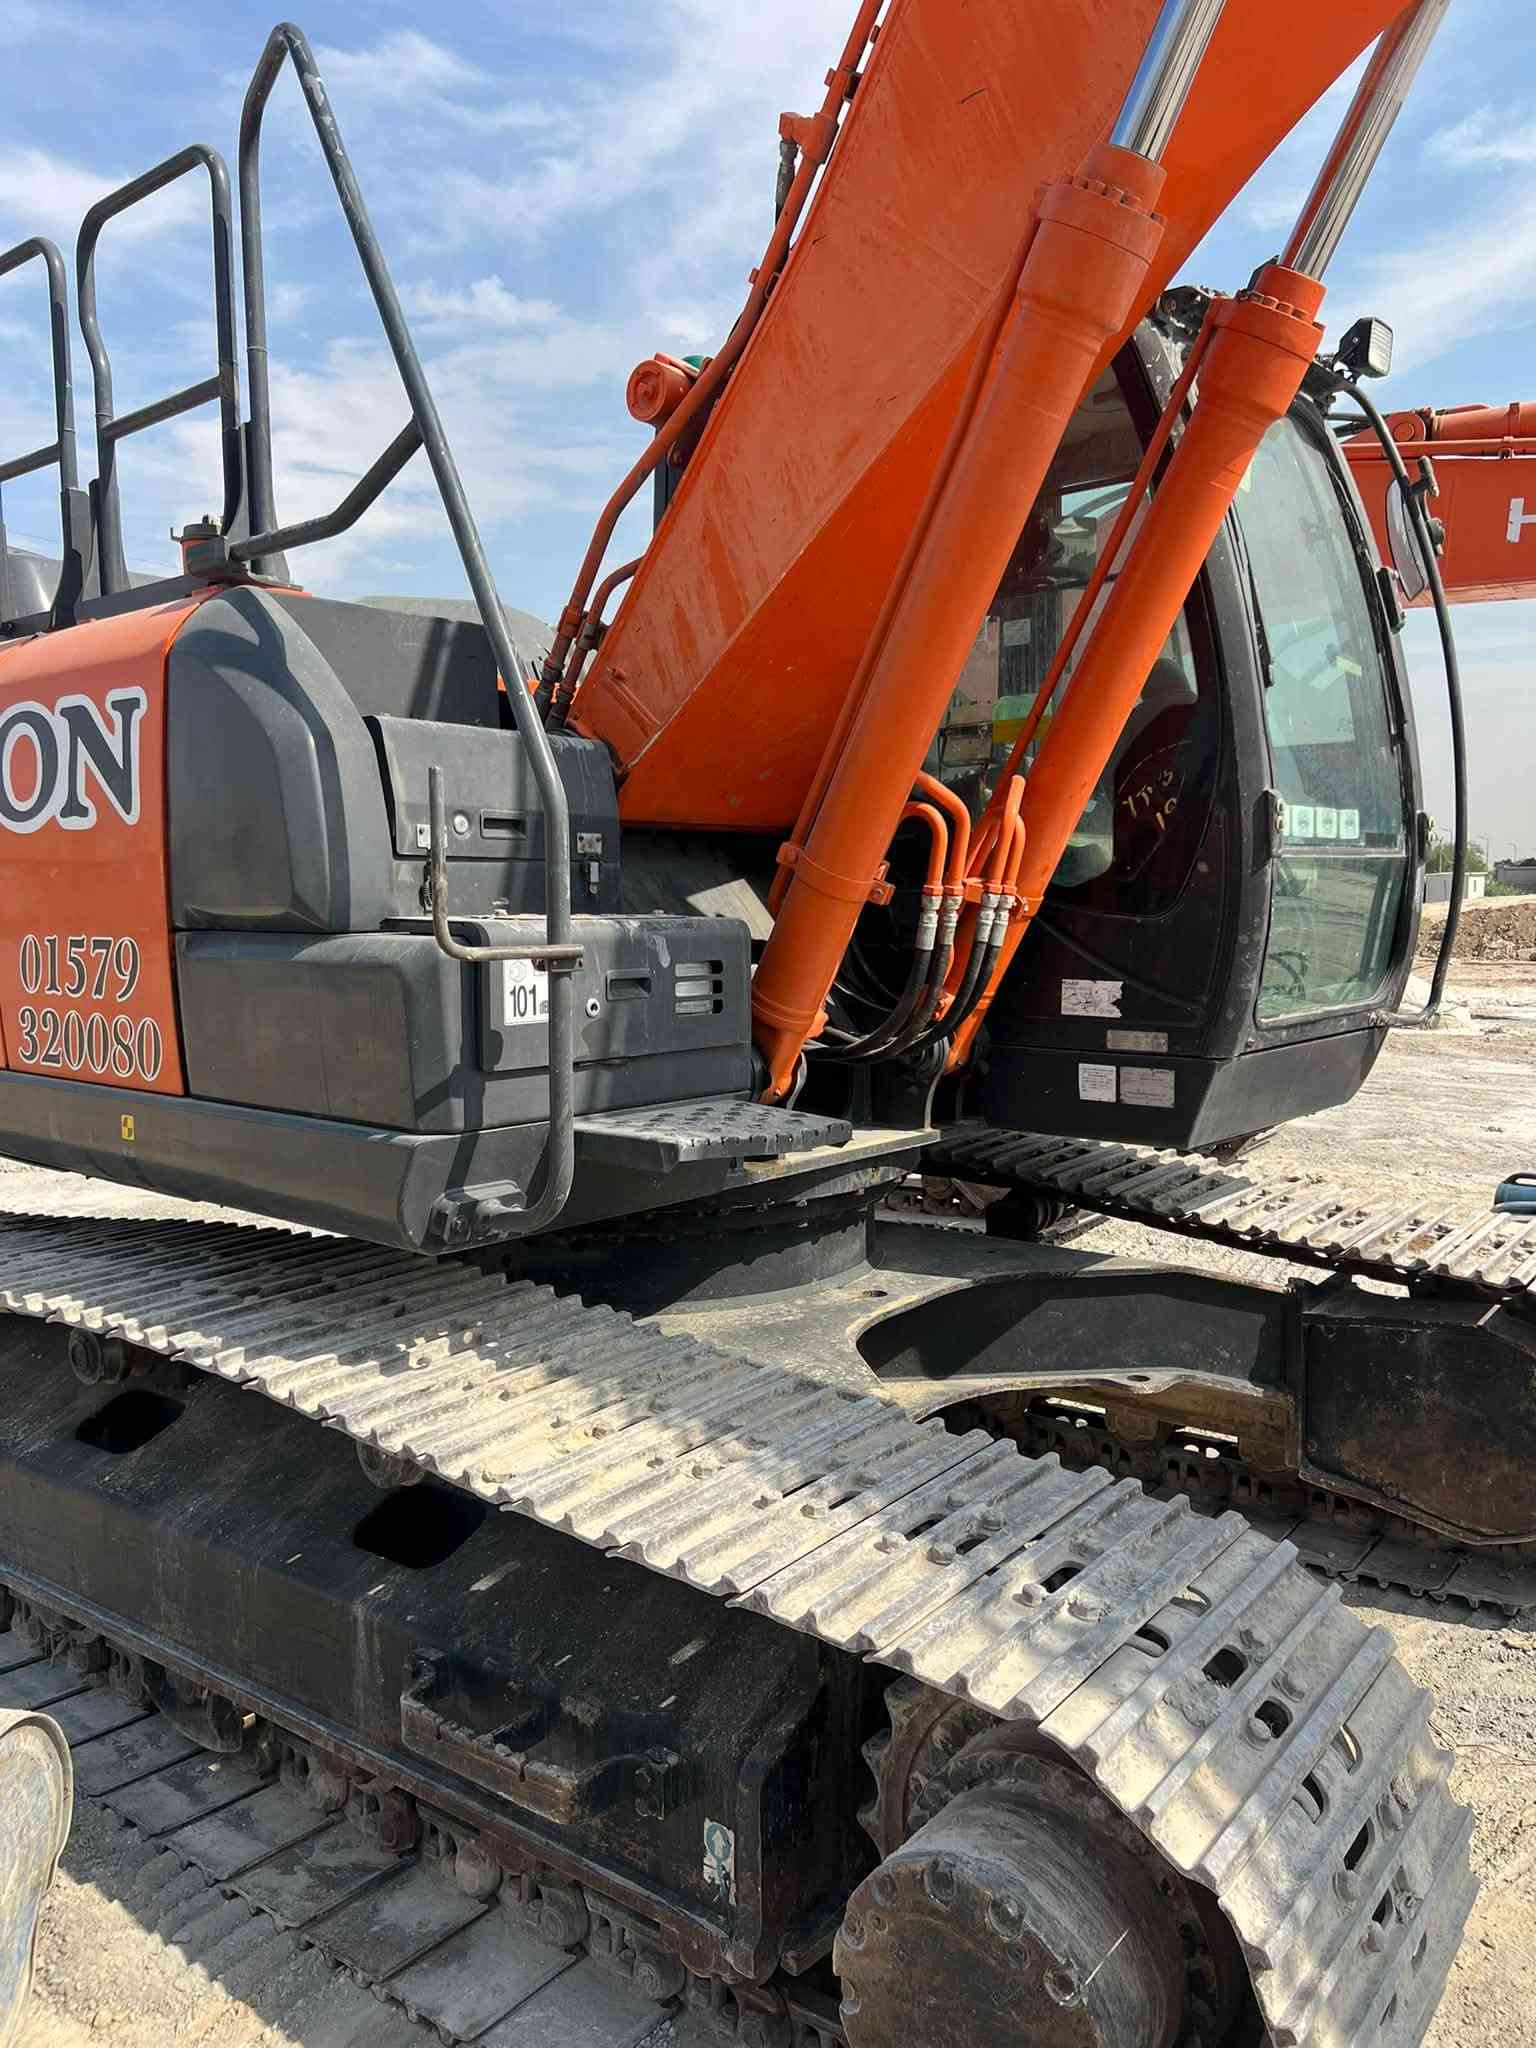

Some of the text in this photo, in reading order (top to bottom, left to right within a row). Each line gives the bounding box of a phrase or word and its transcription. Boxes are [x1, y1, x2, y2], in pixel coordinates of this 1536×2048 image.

[0, 687, 147, 833] ON
[20, 934, 140, 1002] 01579
[509, 984, 537, 1017] 101
[19, 1006, 163, 1081] 320080
